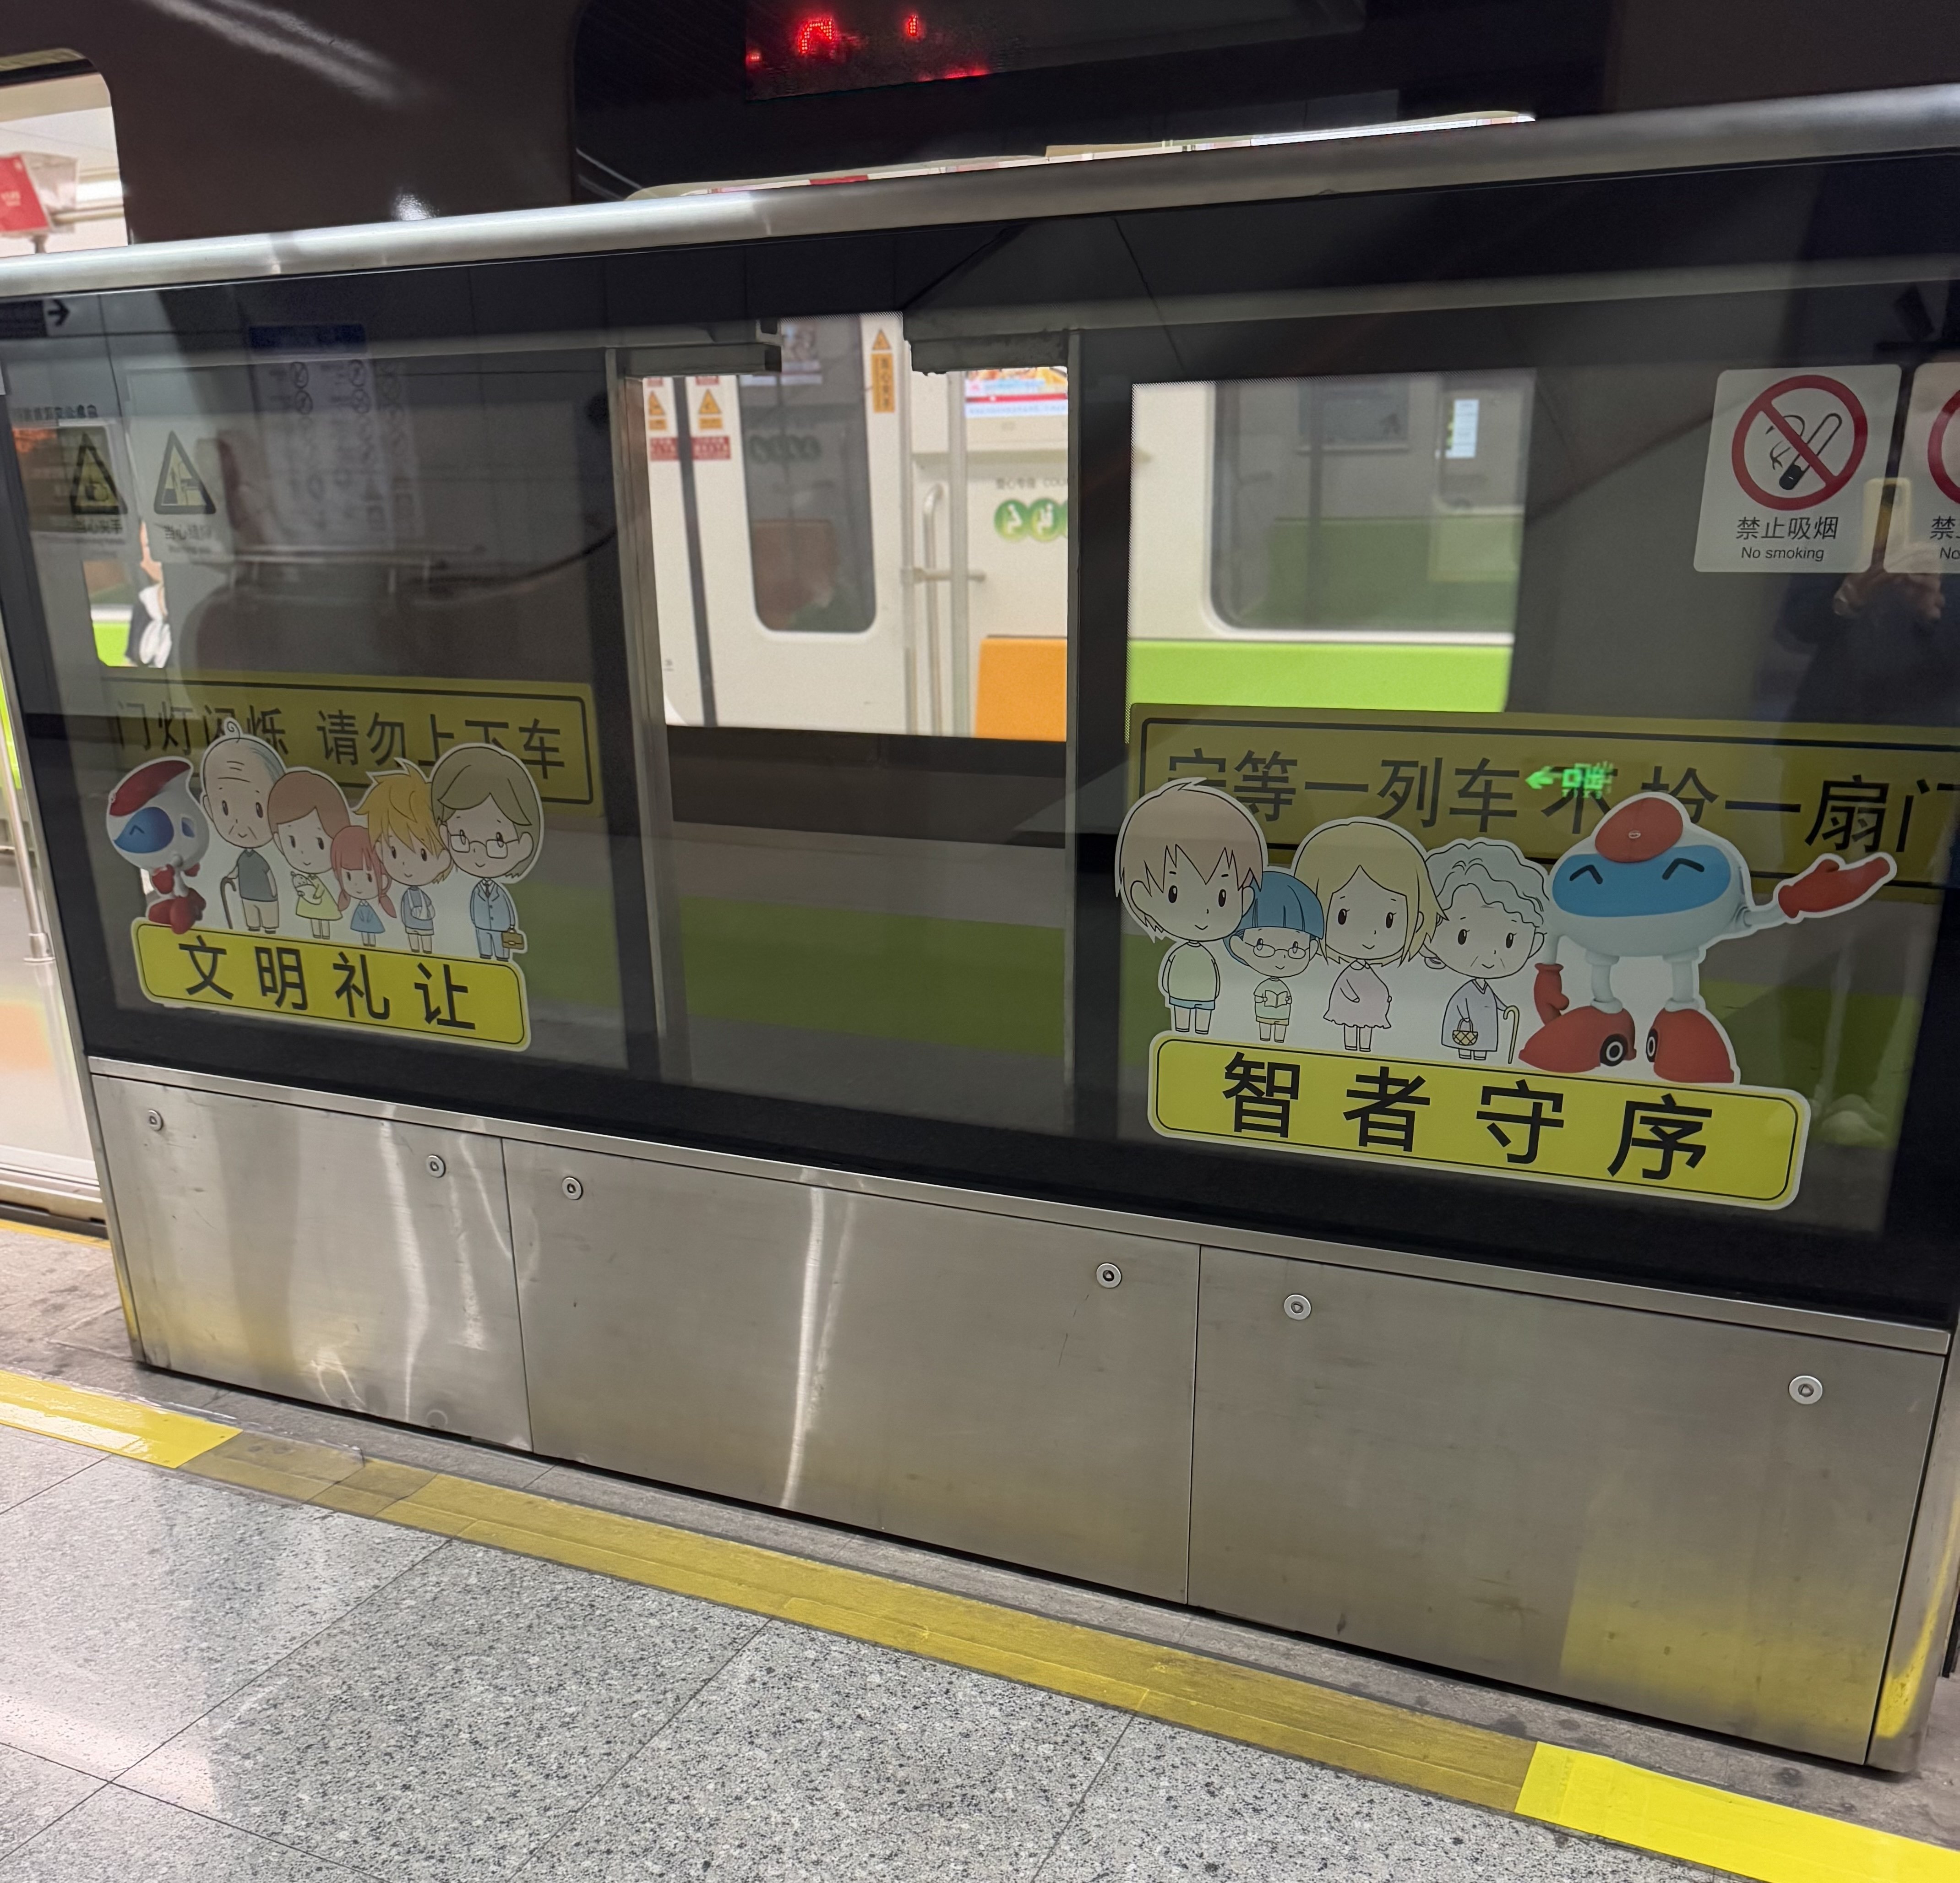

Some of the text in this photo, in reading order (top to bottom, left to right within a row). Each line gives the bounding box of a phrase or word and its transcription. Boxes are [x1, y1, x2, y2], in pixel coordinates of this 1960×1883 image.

[1736, 516, 1839, 540] 禁止吸烟
[1929, 515, 1960, 540] 禁
[1741, 547, 1824, 562] No smoking
[1939, 546, 1960, 560] No
[316, 709, 565, 779] 请勿上下车
[179, 935, 476, 1031] 文明礼让
[1222, 1053, 1714, 1181] 智者守序
